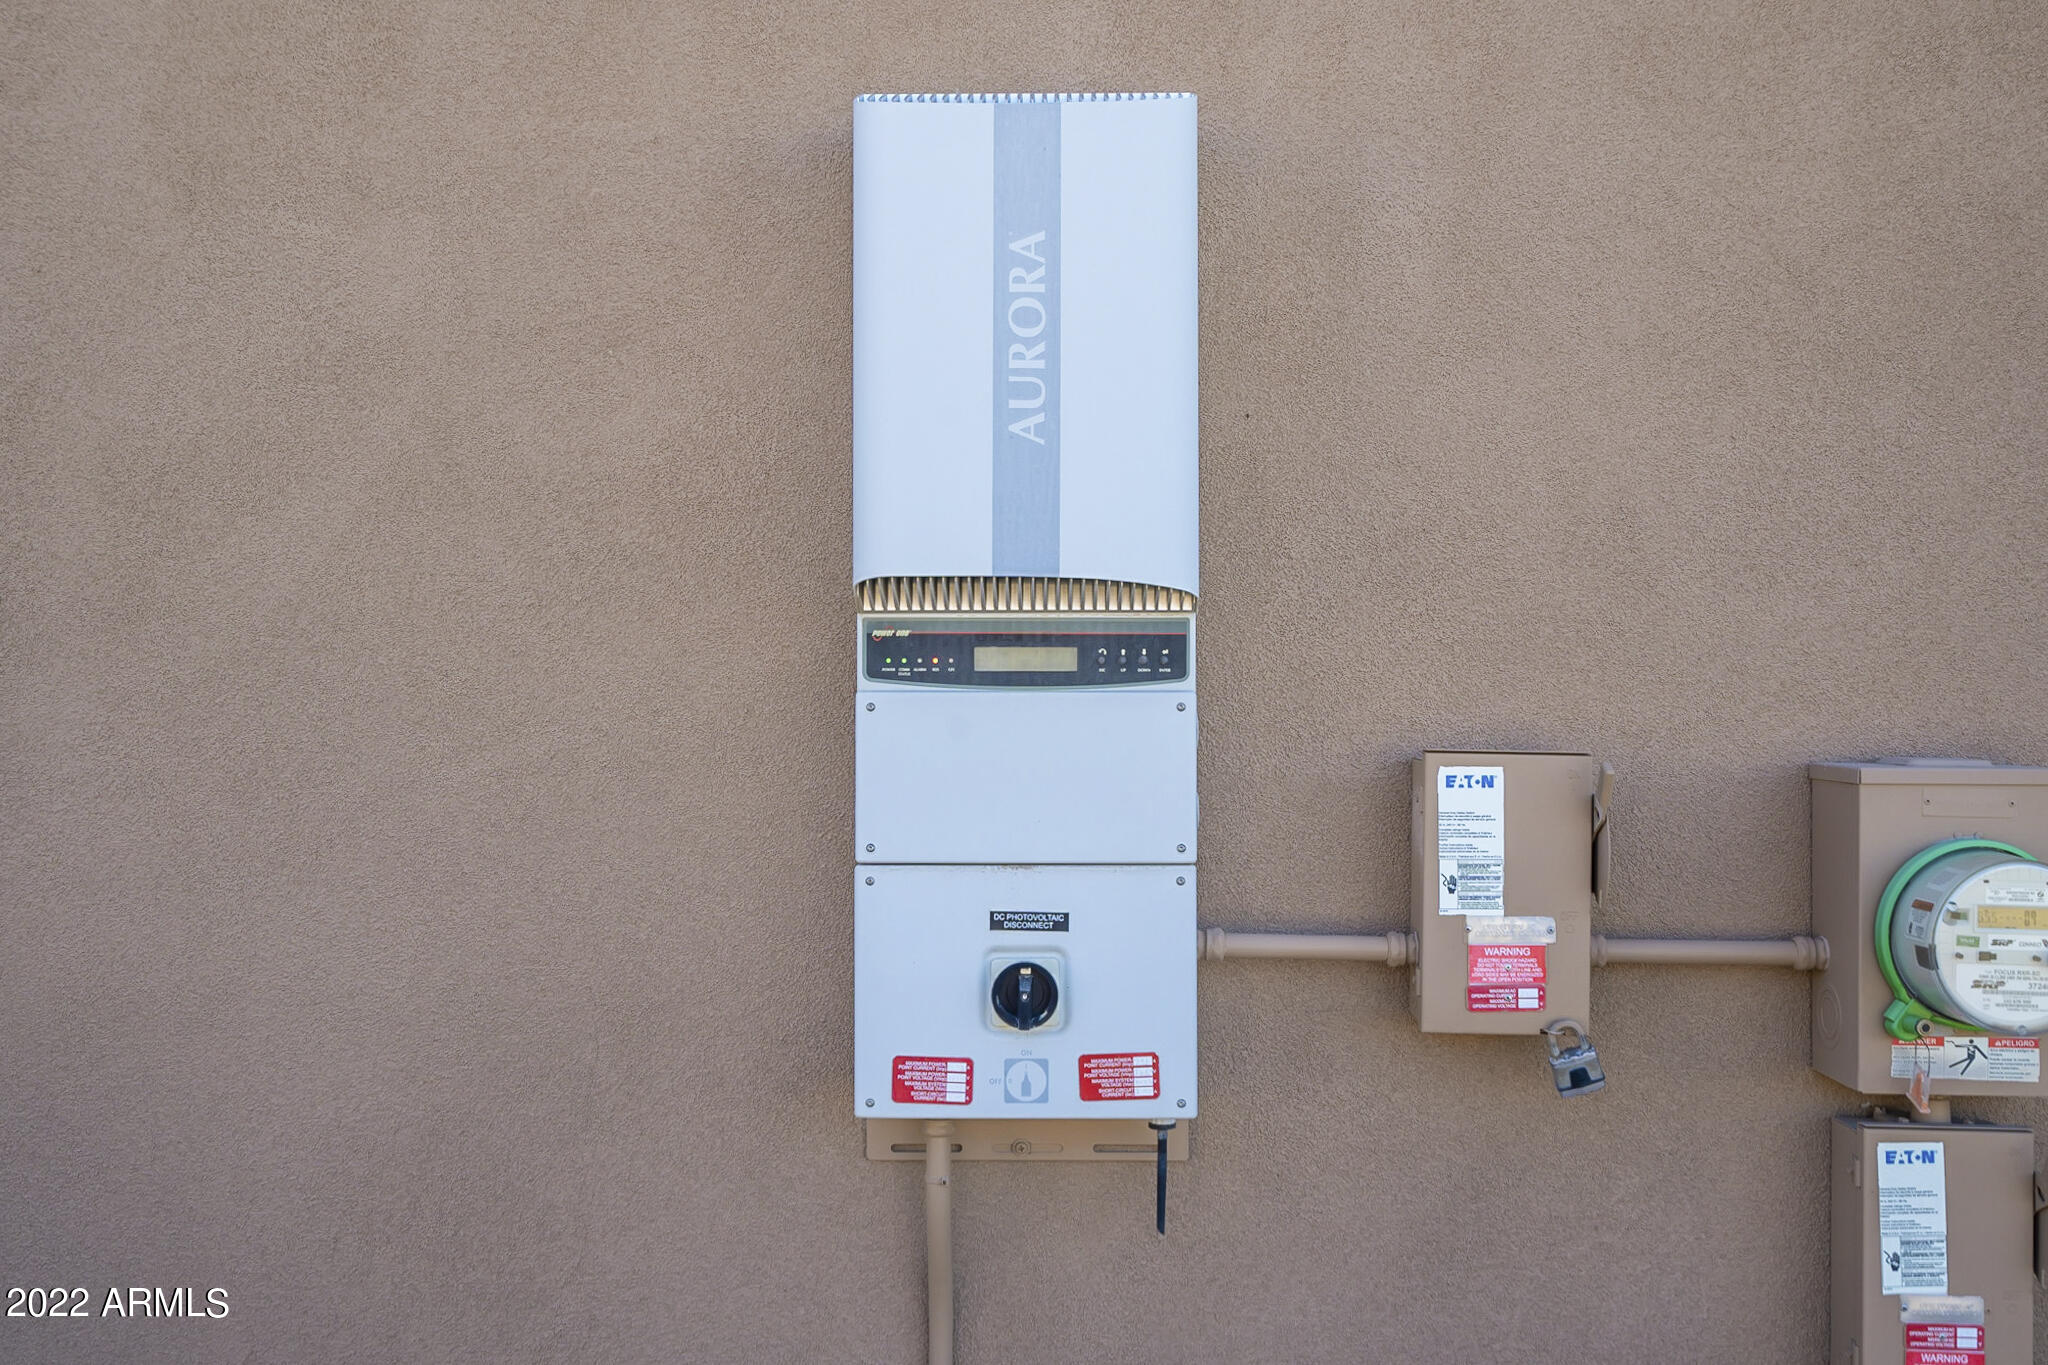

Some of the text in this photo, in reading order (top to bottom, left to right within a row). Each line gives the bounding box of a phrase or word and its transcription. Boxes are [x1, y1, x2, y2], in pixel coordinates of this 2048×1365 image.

[1008, 230, 1046, 445] AURORA
[1006, 914, 1064, 922] PHOTOVOLTAIC
[1484, 948, 1530, 956] WARNING
[1921, 1353, 1968, 1364] WARNING
